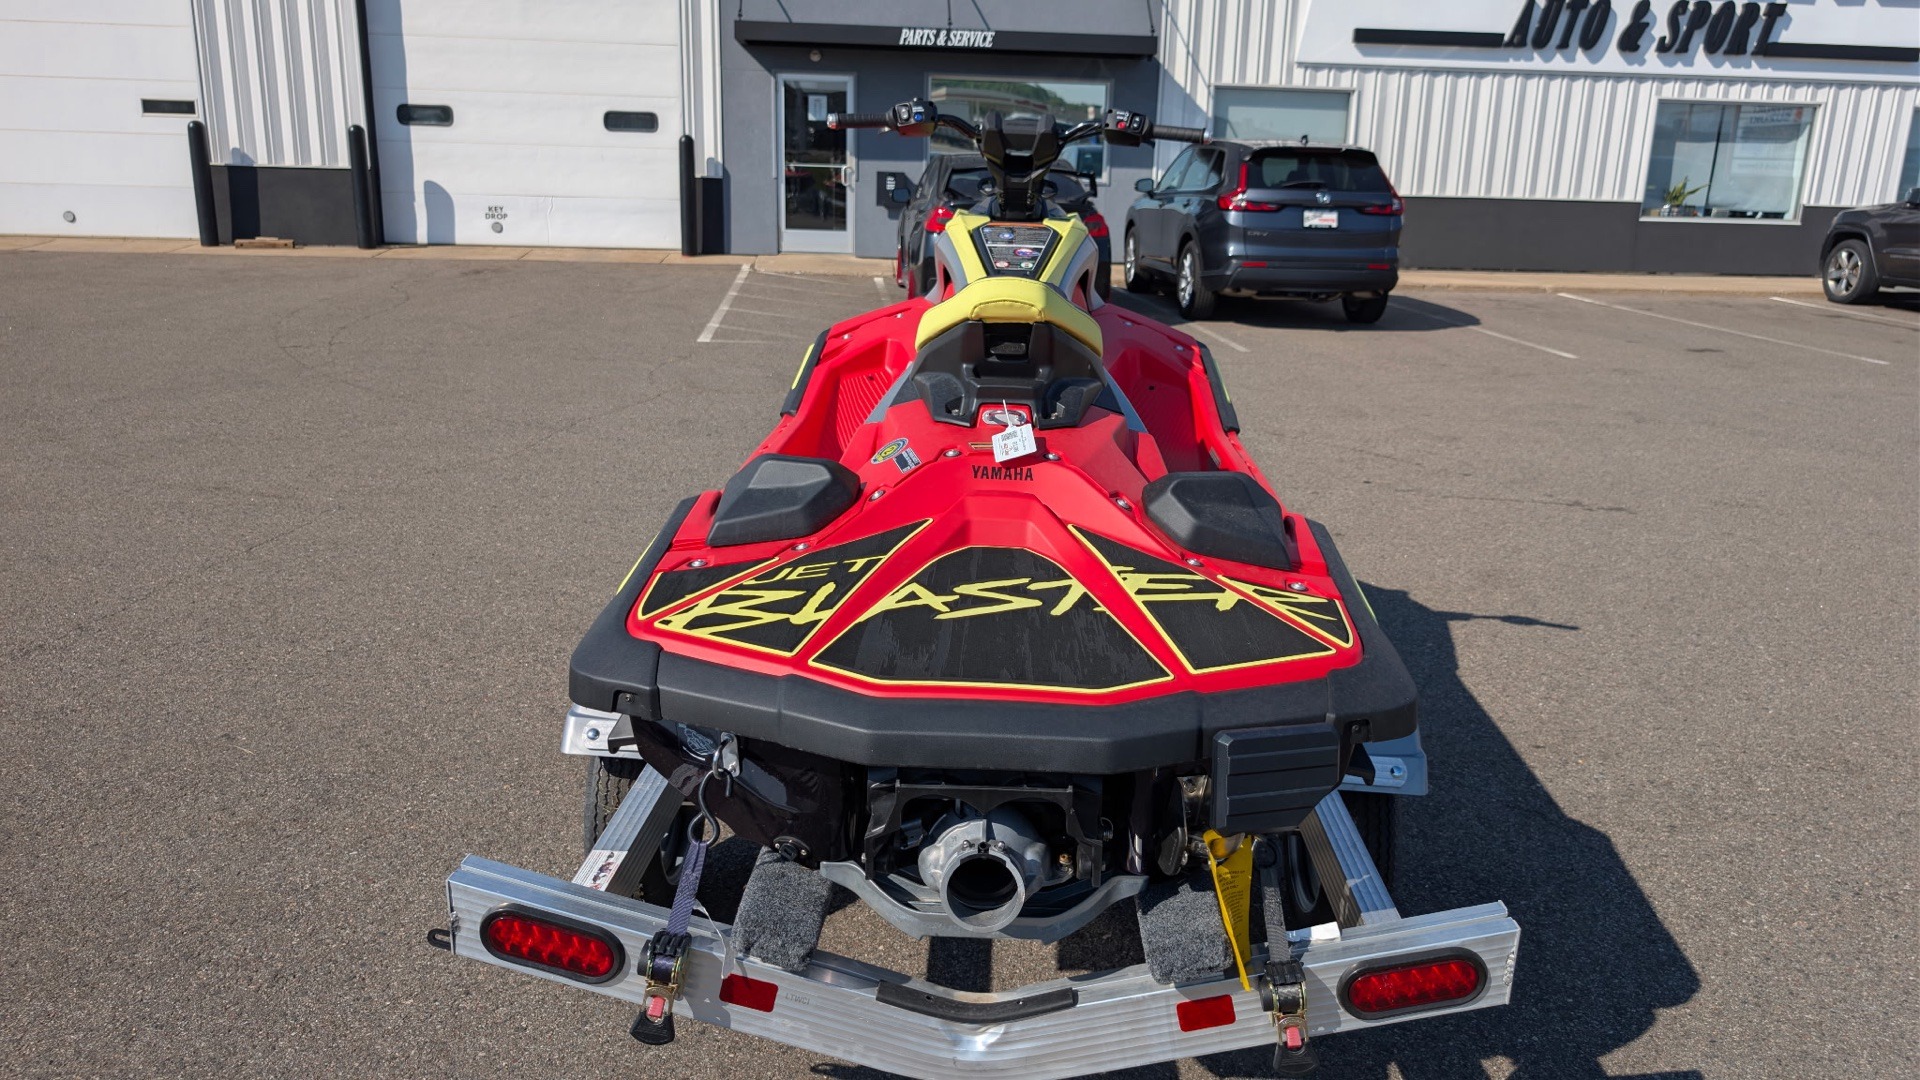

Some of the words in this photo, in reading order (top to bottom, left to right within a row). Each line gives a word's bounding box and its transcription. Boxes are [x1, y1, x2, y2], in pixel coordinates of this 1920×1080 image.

[899, 28, 937, 46] PARTS
[937, 29, 948, 46] &
[947, 30, 996, 48] SERVICE
[1504, 0, 1611, 50] AUTO
[1617, 0, 1650, 53] &
[1656, 0, 1787, 57] SPORT
[488, 205, 504, 213] KEY
[972, 465, 1034, 481] YAMAHA
[743, 556, 885, 586] JET
[655, 567, 1338, 636] BLASTER
